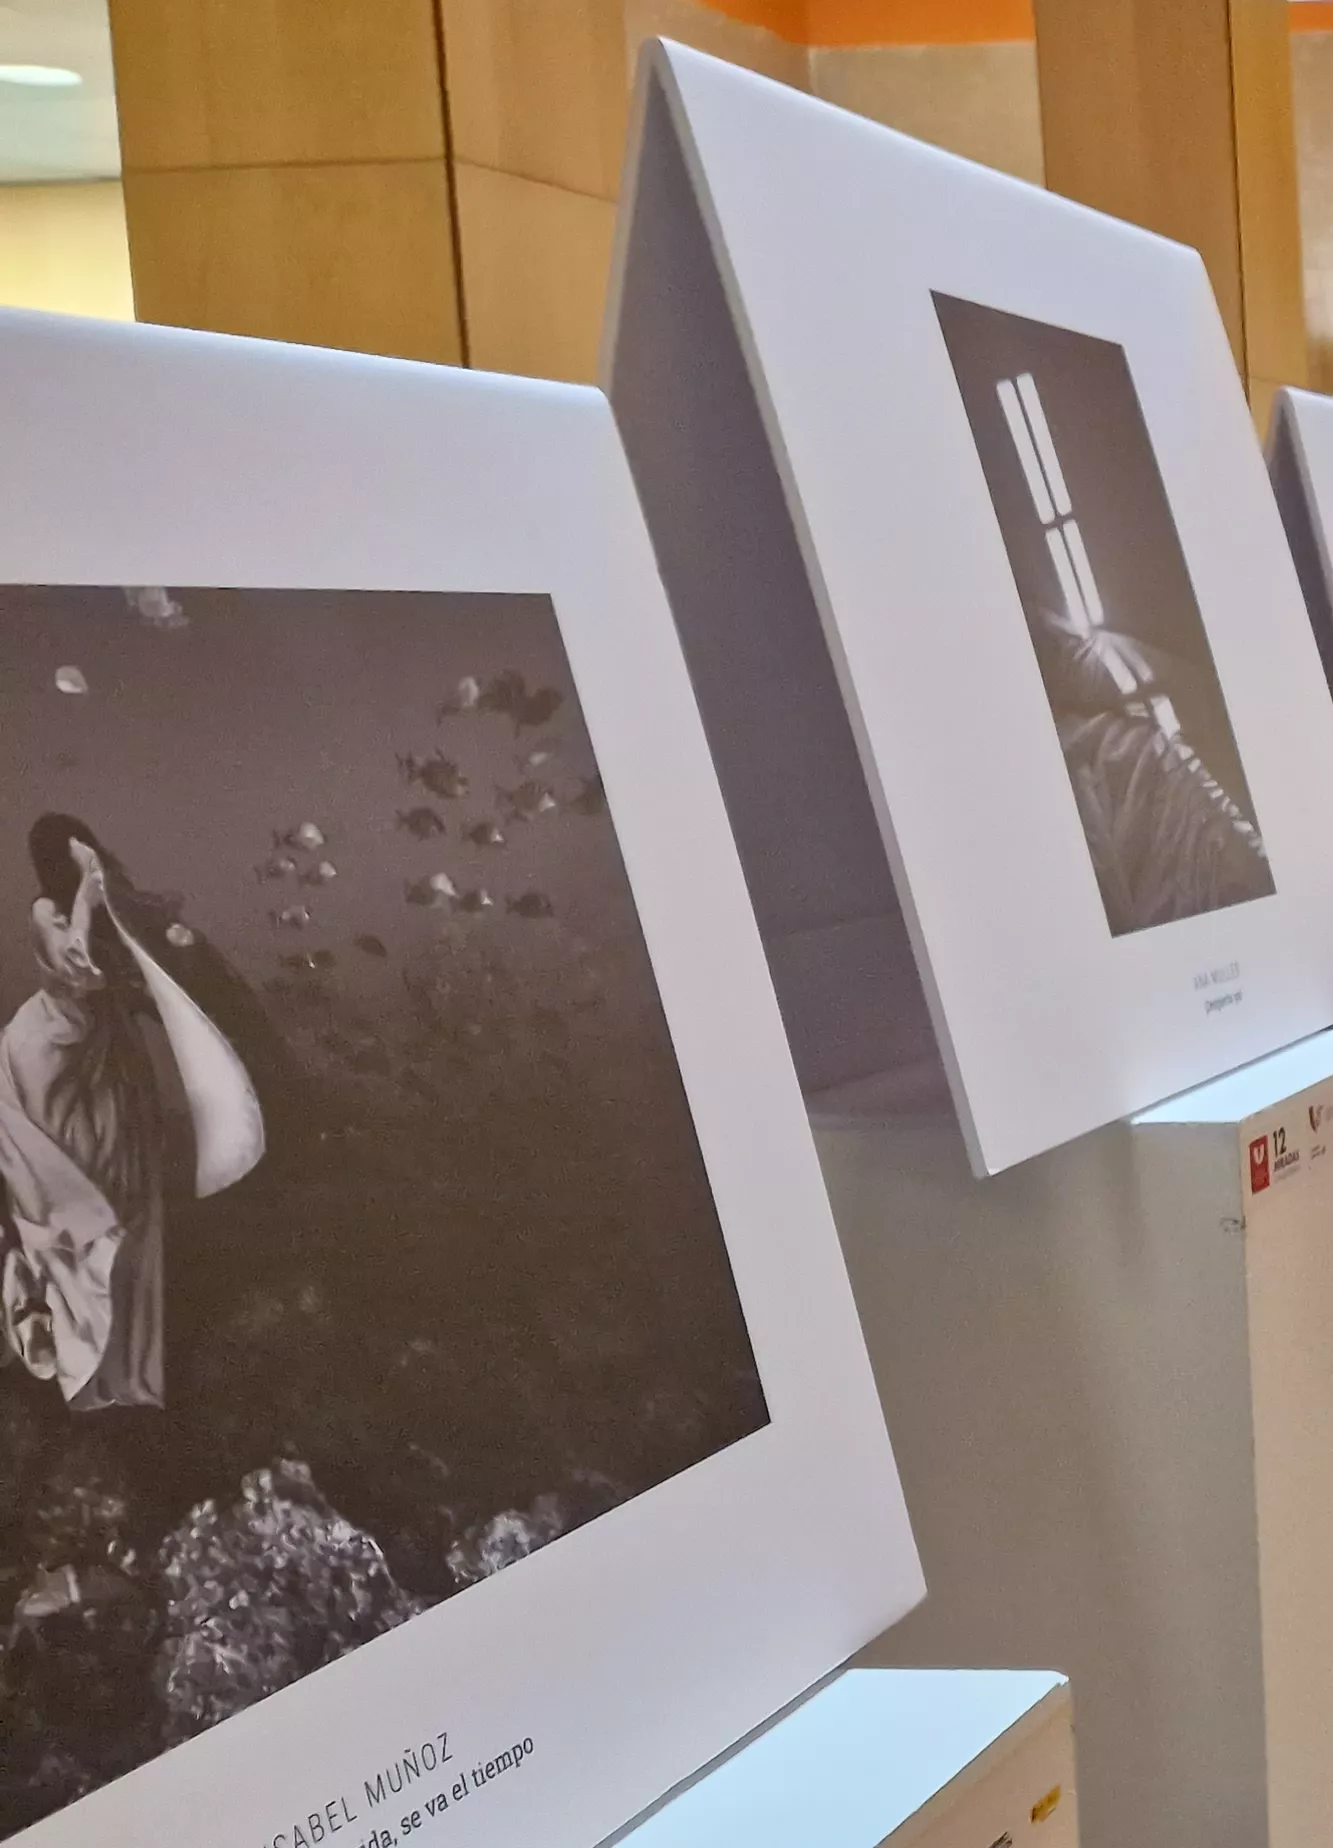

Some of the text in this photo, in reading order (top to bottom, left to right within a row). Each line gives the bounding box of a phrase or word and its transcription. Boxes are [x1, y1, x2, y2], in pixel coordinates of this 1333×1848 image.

[1273, 1126, 1287, 1158] 12
[262, 1731, 453, 1848] ABEL MUÑOZ
[399, 1809, 422, 1836] se
[424, 1792, 449, 1818] va
[451, 1772, 470, 1802] el
[471, 1736, 534, 1789] tiempo
